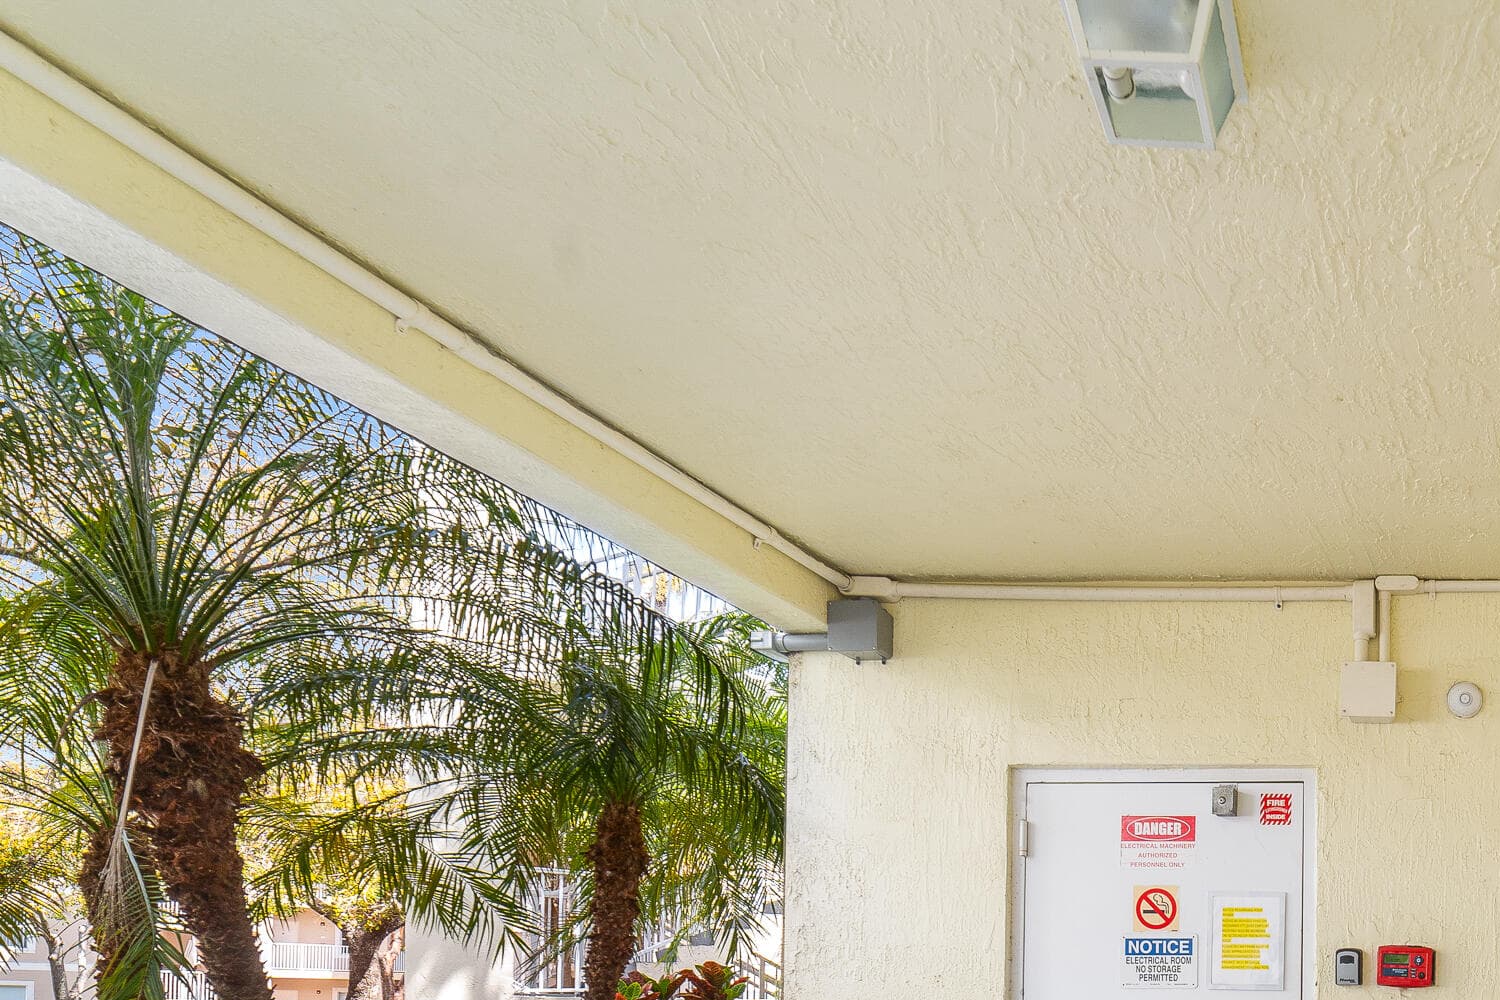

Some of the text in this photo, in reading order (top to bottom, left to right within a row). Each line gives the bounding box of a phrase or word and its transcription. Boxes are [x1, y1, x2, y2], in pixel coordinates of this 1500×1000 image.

[1266, 799, 1286, 807] FIRE
[1134, 821, 1182, 836] DANGER
[1128, 940, 1190, 954] NOTICE
[1125, 956, 1192, 965] ELECTRICAL ROOM
[1135, 965, 1182, 973] NO STORAGE
[1138, 973, 1179, 982] PERMITTED
